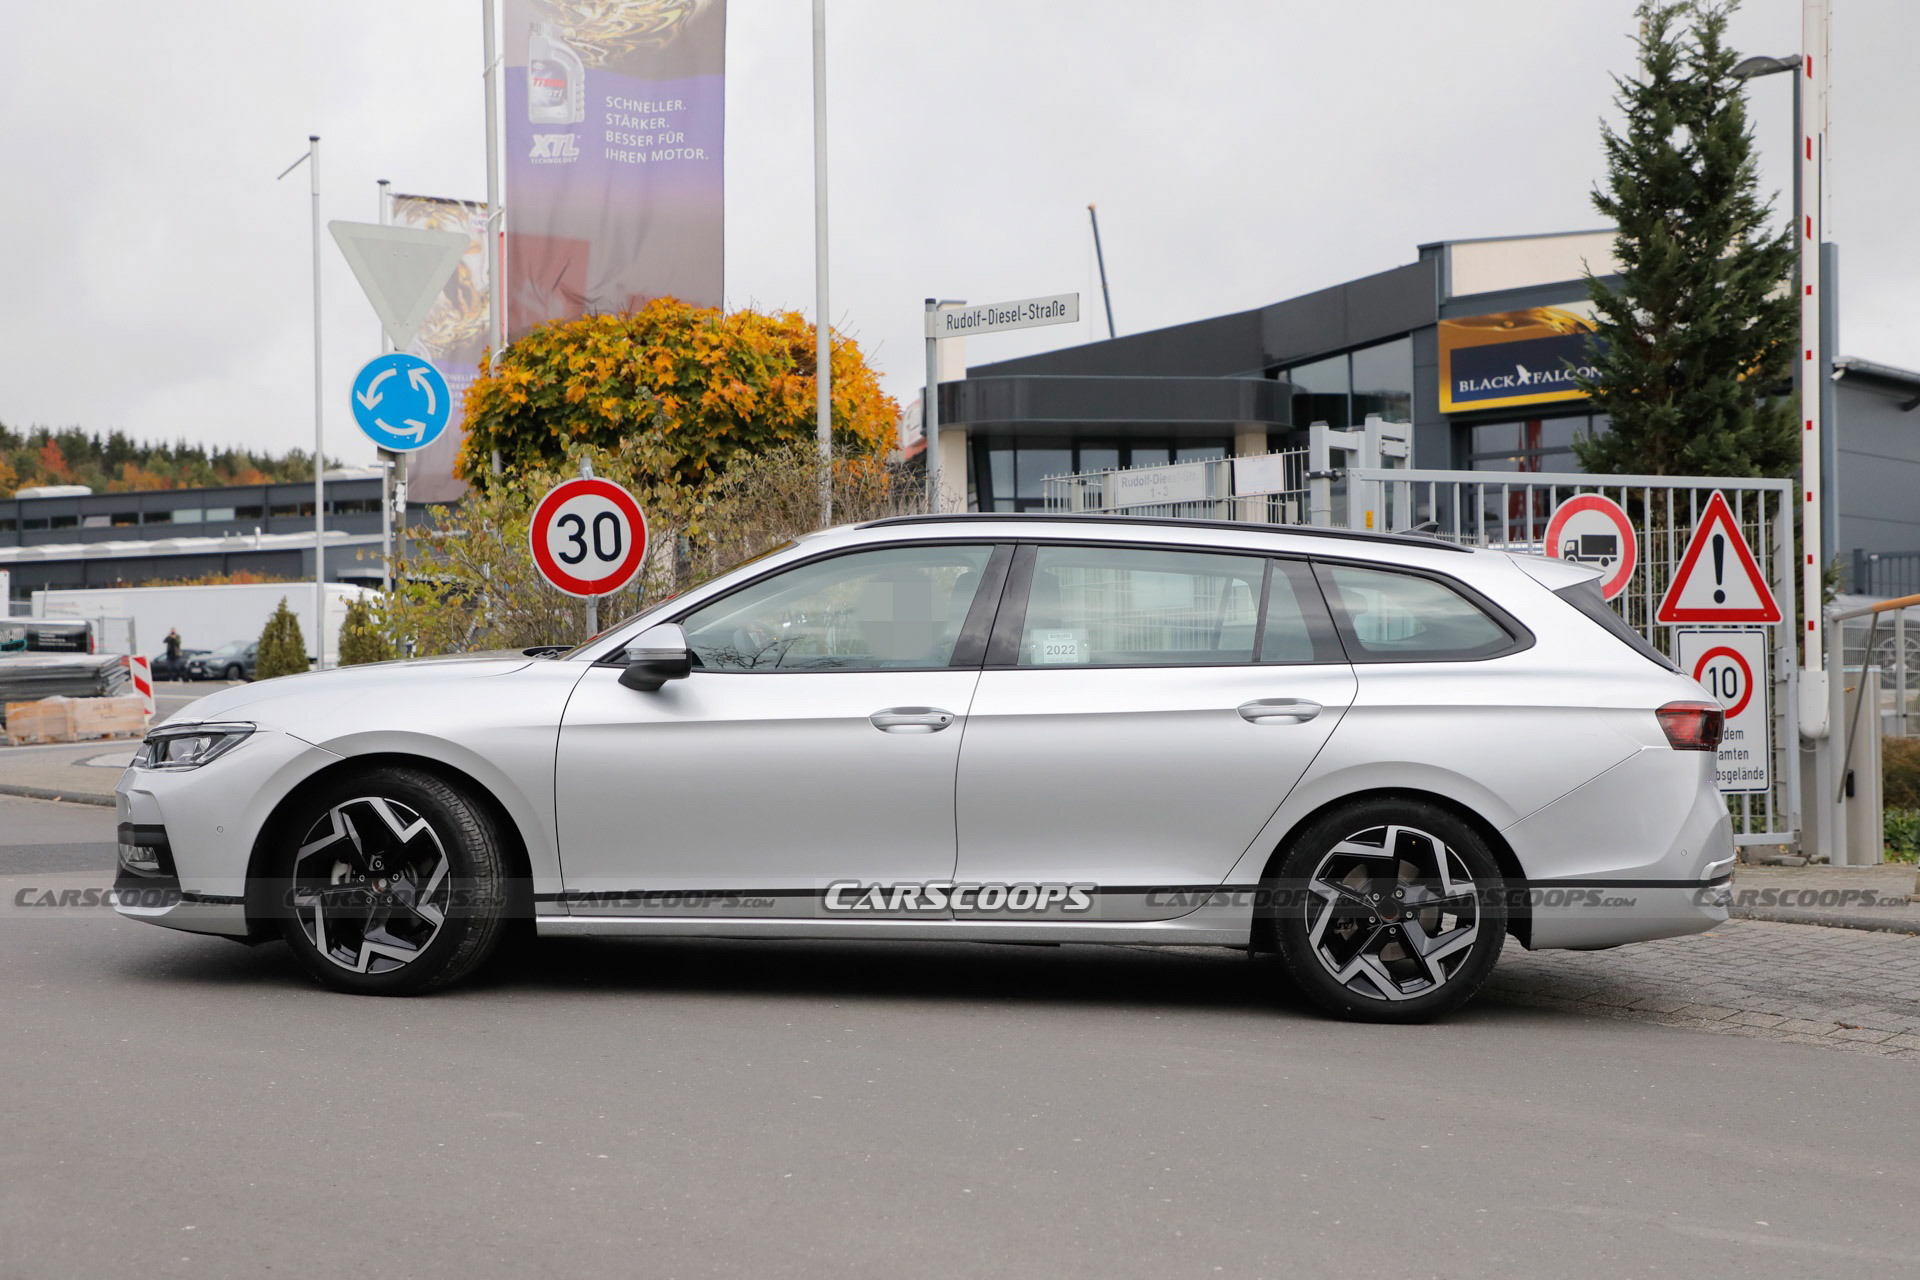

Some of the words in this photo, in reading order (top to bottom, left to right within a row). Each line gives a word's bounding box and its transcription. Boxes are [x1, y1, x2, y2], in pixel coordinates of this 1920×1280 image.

[606, 96, 687, 113] SCHNELLER.
[606, 113, 670, 130] STÄRKER.
[529, 134, 580, 157] XTL
[606, 130, 654, 147] BESSER
[658, 131, 684, 145] FÜR
[605, 147, 647, 163] IHREN
[651, 148, 709, 161] MOTOR.
[946, 300, 1066, 331] Rudolf-Diesel-Straße
[1458, 374, 1515, 393] BLACK
[1533, 366, 1603, 384] FALCON
[1163, 486, 1169, 497] 3
[557, 511, 622, 564] 30
[1046, 645, 1076, 655] 2022
[1709, 666, 1737, 699] 10
[1723, 726, 1744, 740] dem
[1718, 748, 1749, 760] amten
[1716, 766, 1764, 784] bsgelände
